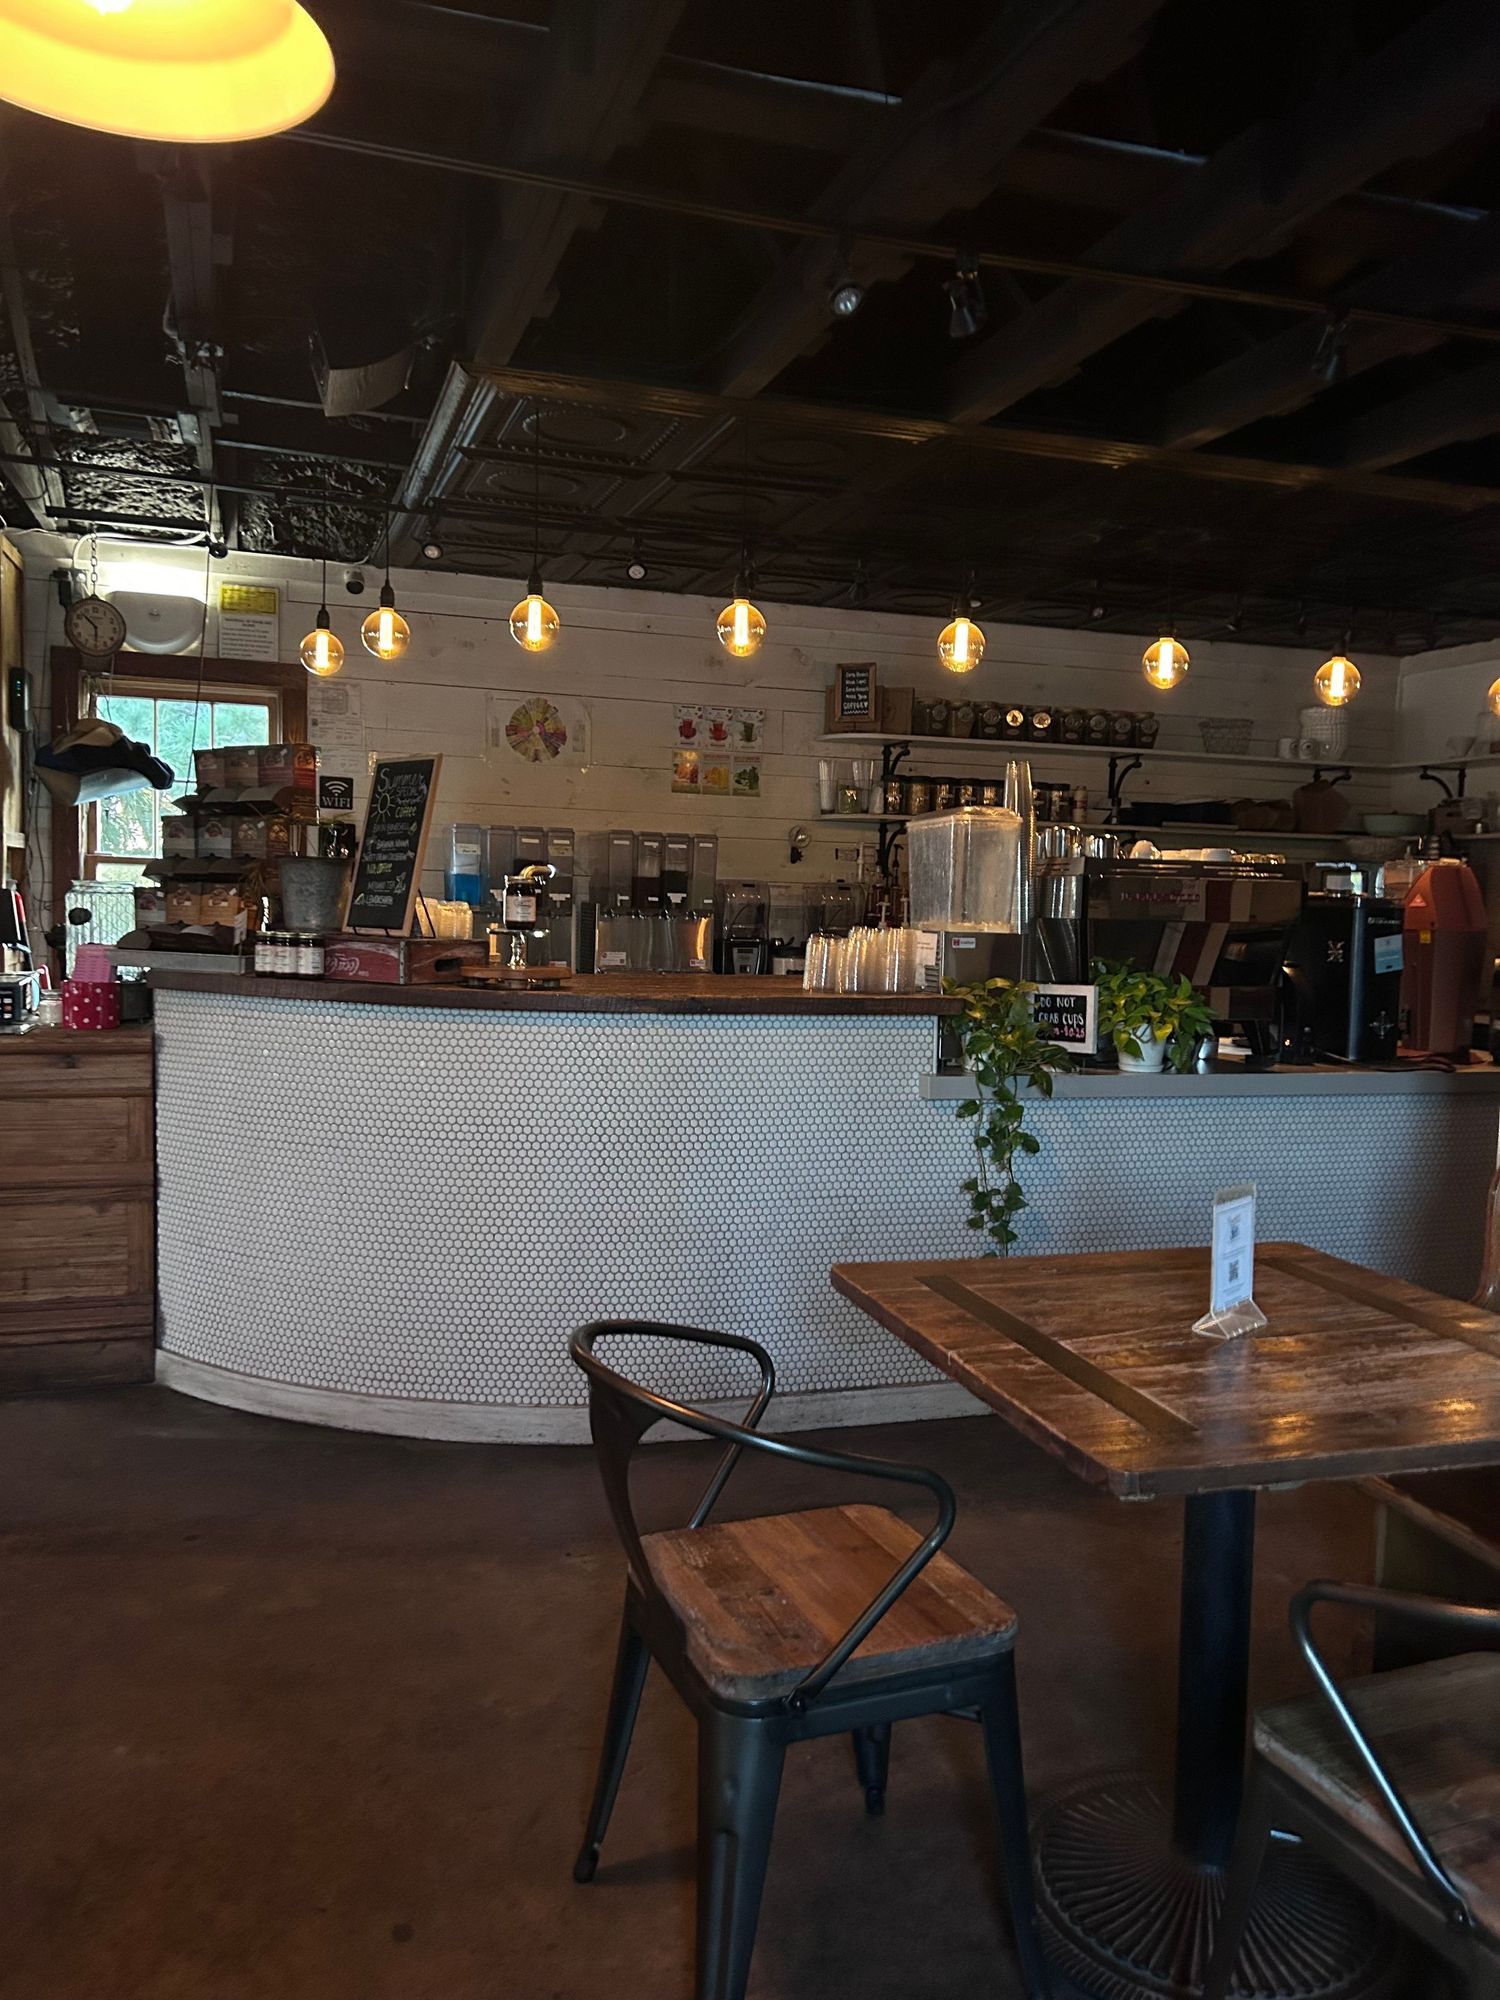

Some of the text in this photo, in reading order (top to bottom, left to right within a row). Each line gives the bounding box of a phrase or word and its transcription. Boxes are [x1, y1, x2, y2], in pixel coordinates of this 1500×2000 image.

[321, 796, 350, 808] WIFI
[1040, 996, 1076, 1008] DO NOT
